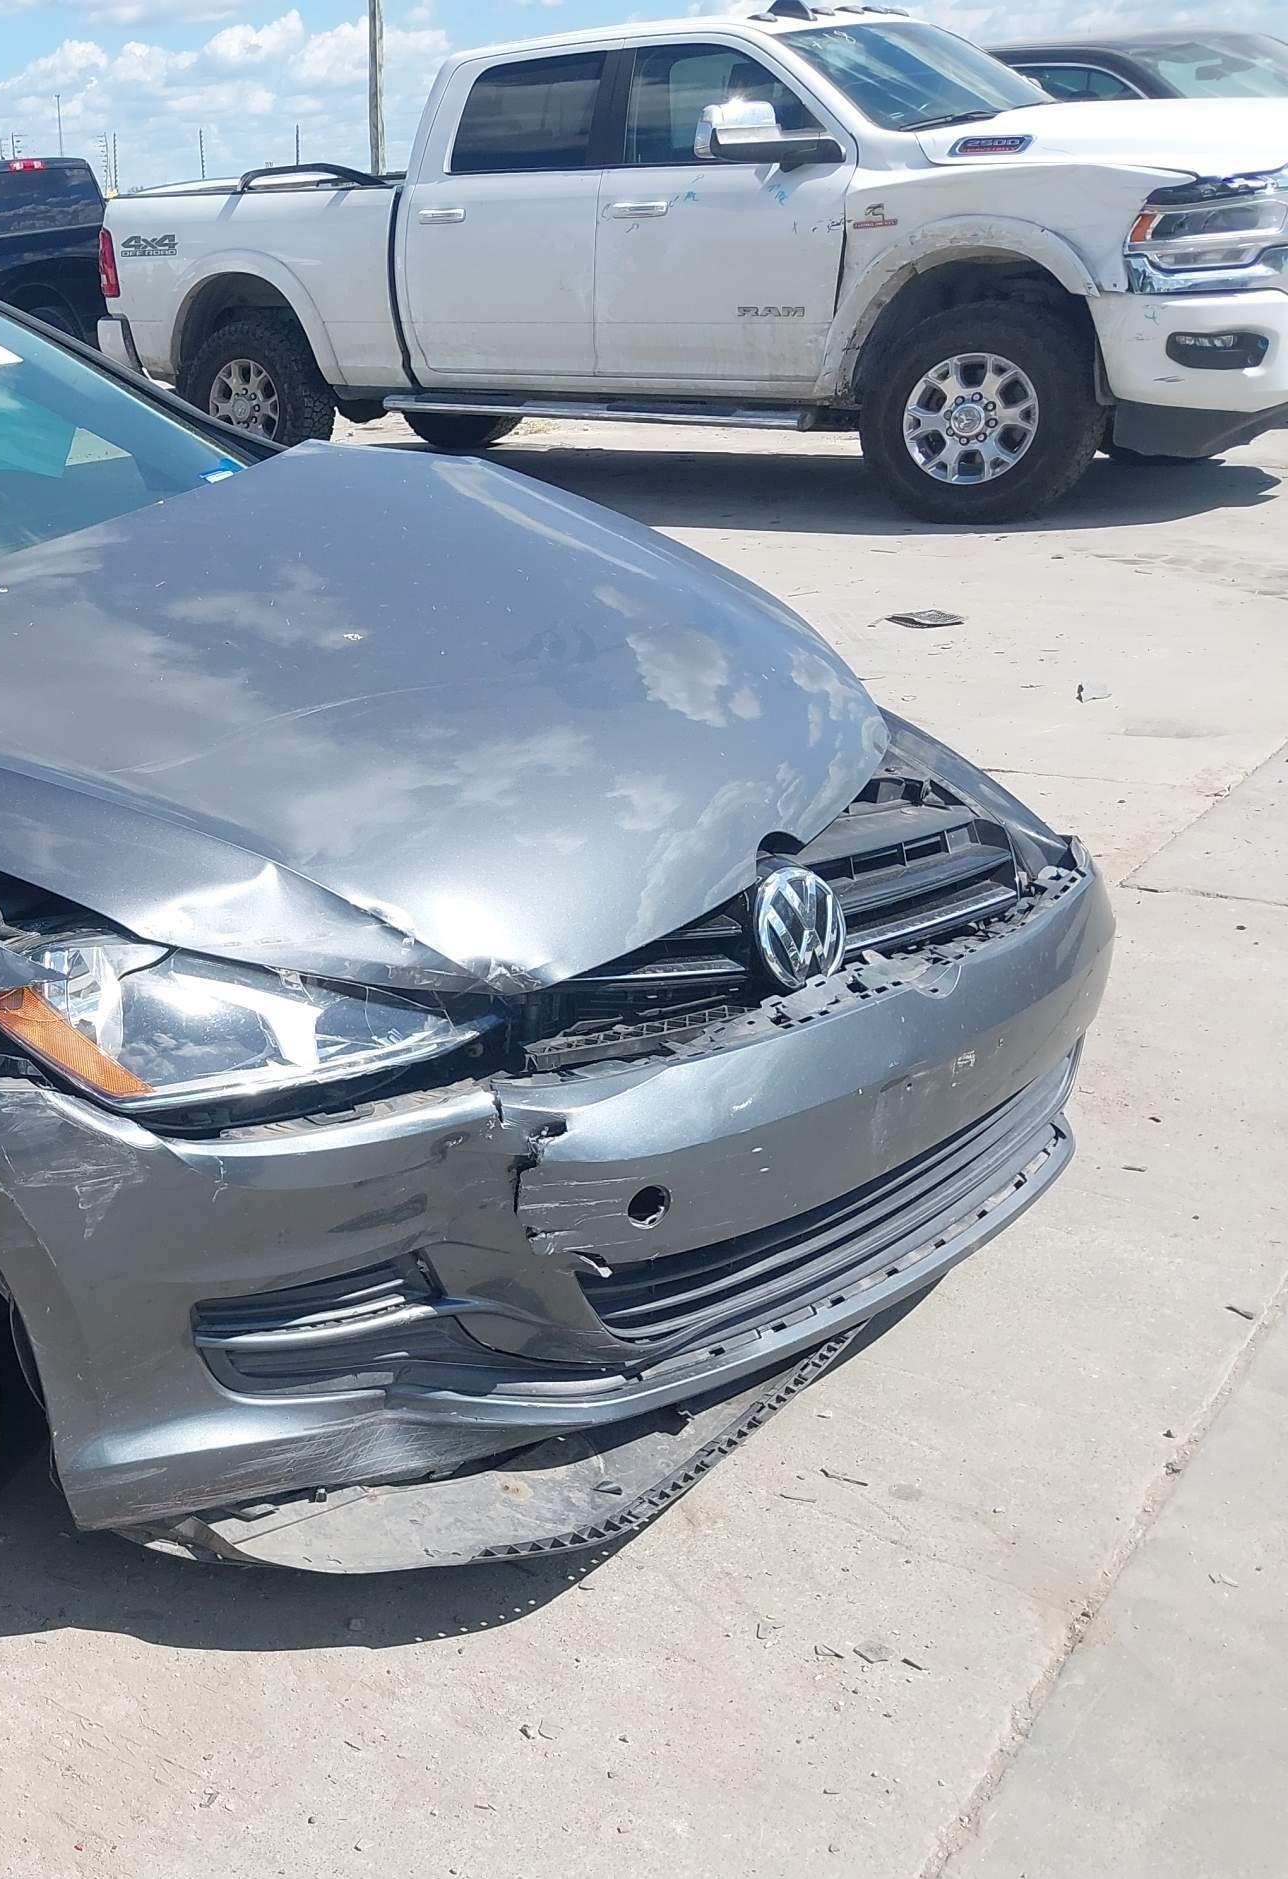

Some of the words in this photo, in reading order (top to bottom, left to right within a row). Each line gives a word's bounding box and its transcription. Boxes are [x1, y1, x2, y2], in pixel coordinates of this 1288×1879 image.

[966, 138, 1020, 147] 2500
[121, 234, 178, 250] 4x4
[737, 306, 806, 317] RAM
